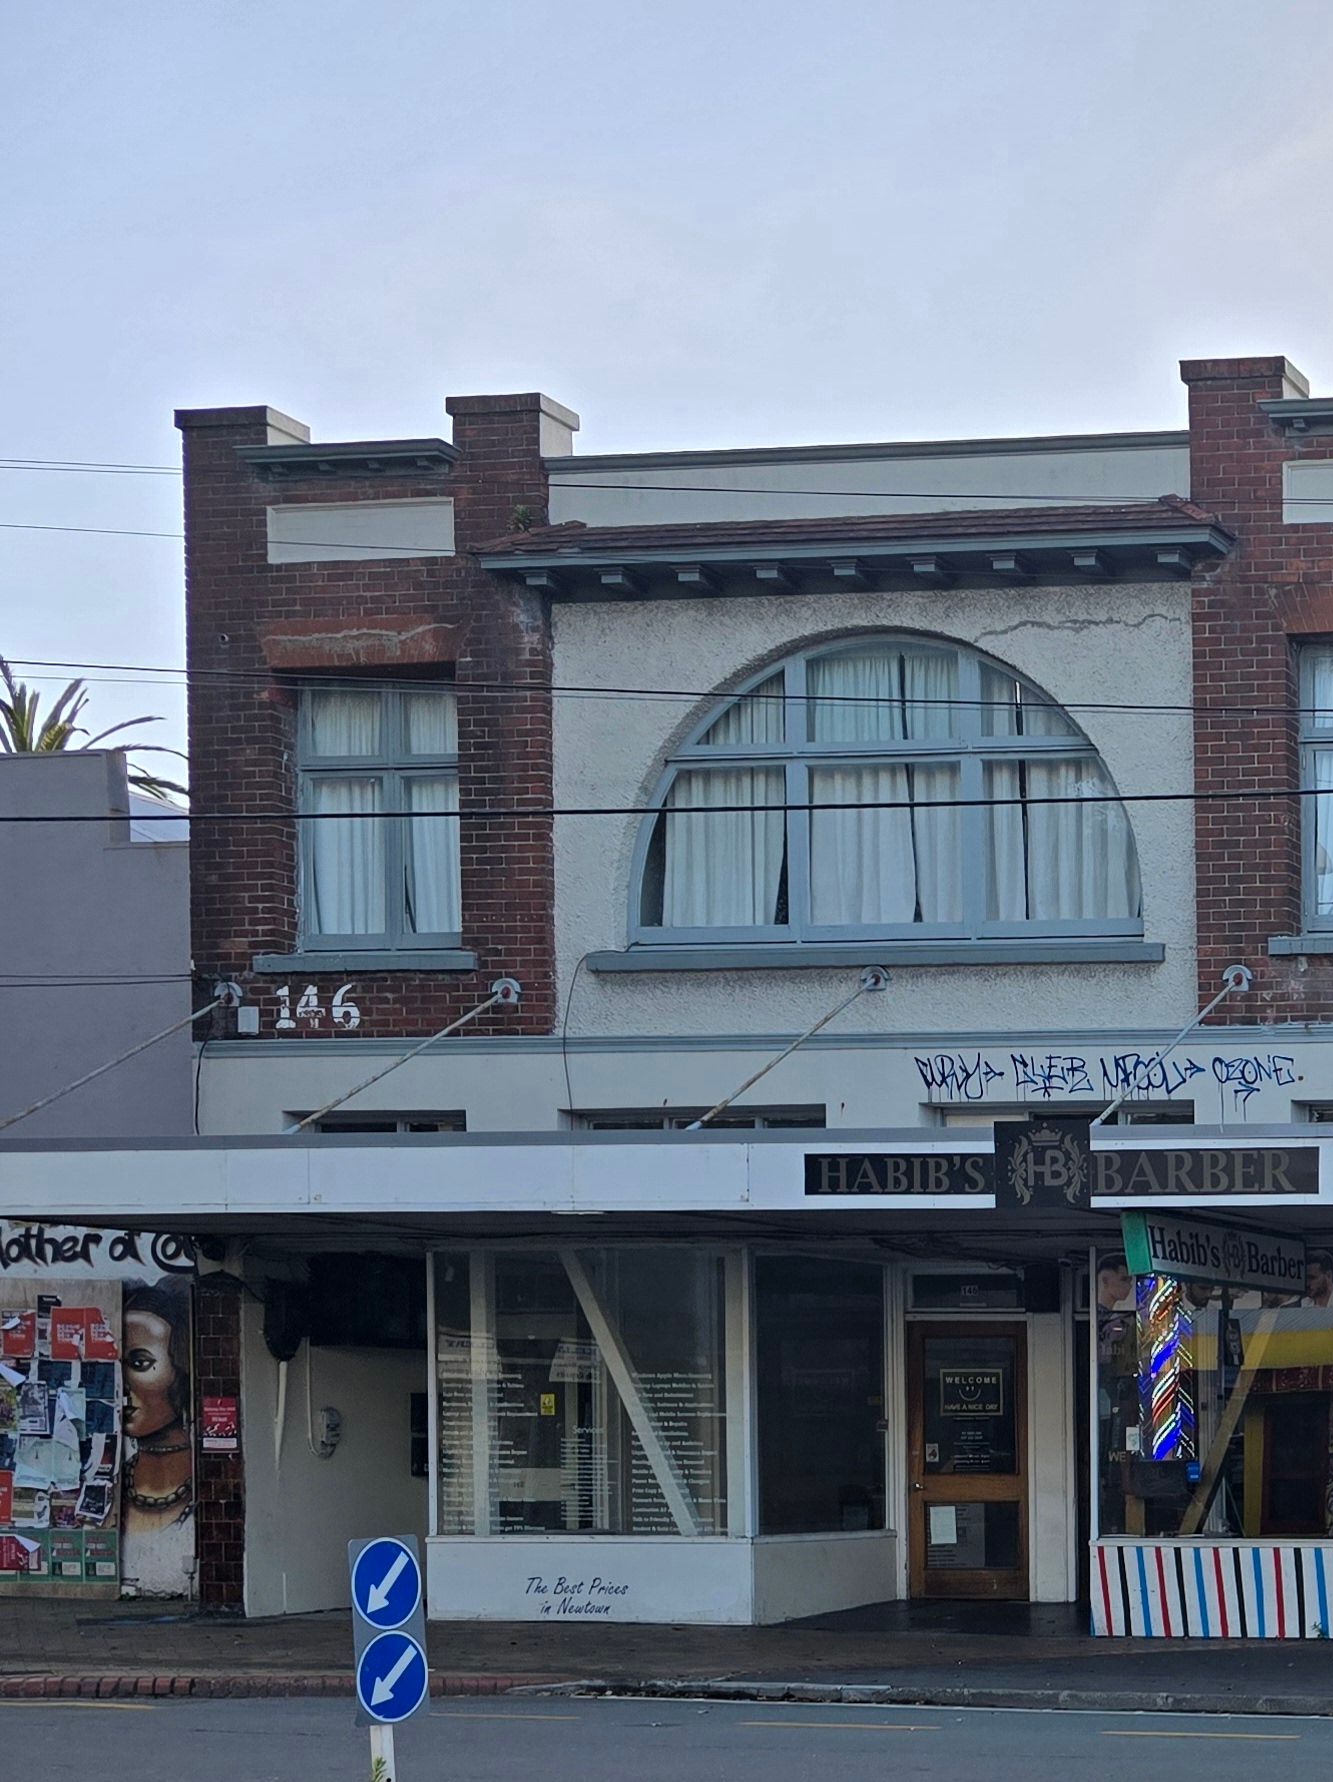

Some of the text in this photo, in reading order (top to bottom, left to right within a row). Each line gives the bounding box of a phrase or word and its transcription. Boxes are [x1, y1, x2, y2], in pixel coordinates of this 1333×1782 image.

[275, 983, 361, 1029] 146
[817, 1157, 986, 1194] HABIB'S
[1094, 1149, 1297, 1194] BARBER
[1148, 1225, 1221, 1269] Habib's
[1246, 1241, 1305, 1281] Barber
[945, 1376, 997, 1384] WELCOME
[525, 1577, 629, 1595] The Best Prices
[541, 1597, 611, 1615] in Newtown
